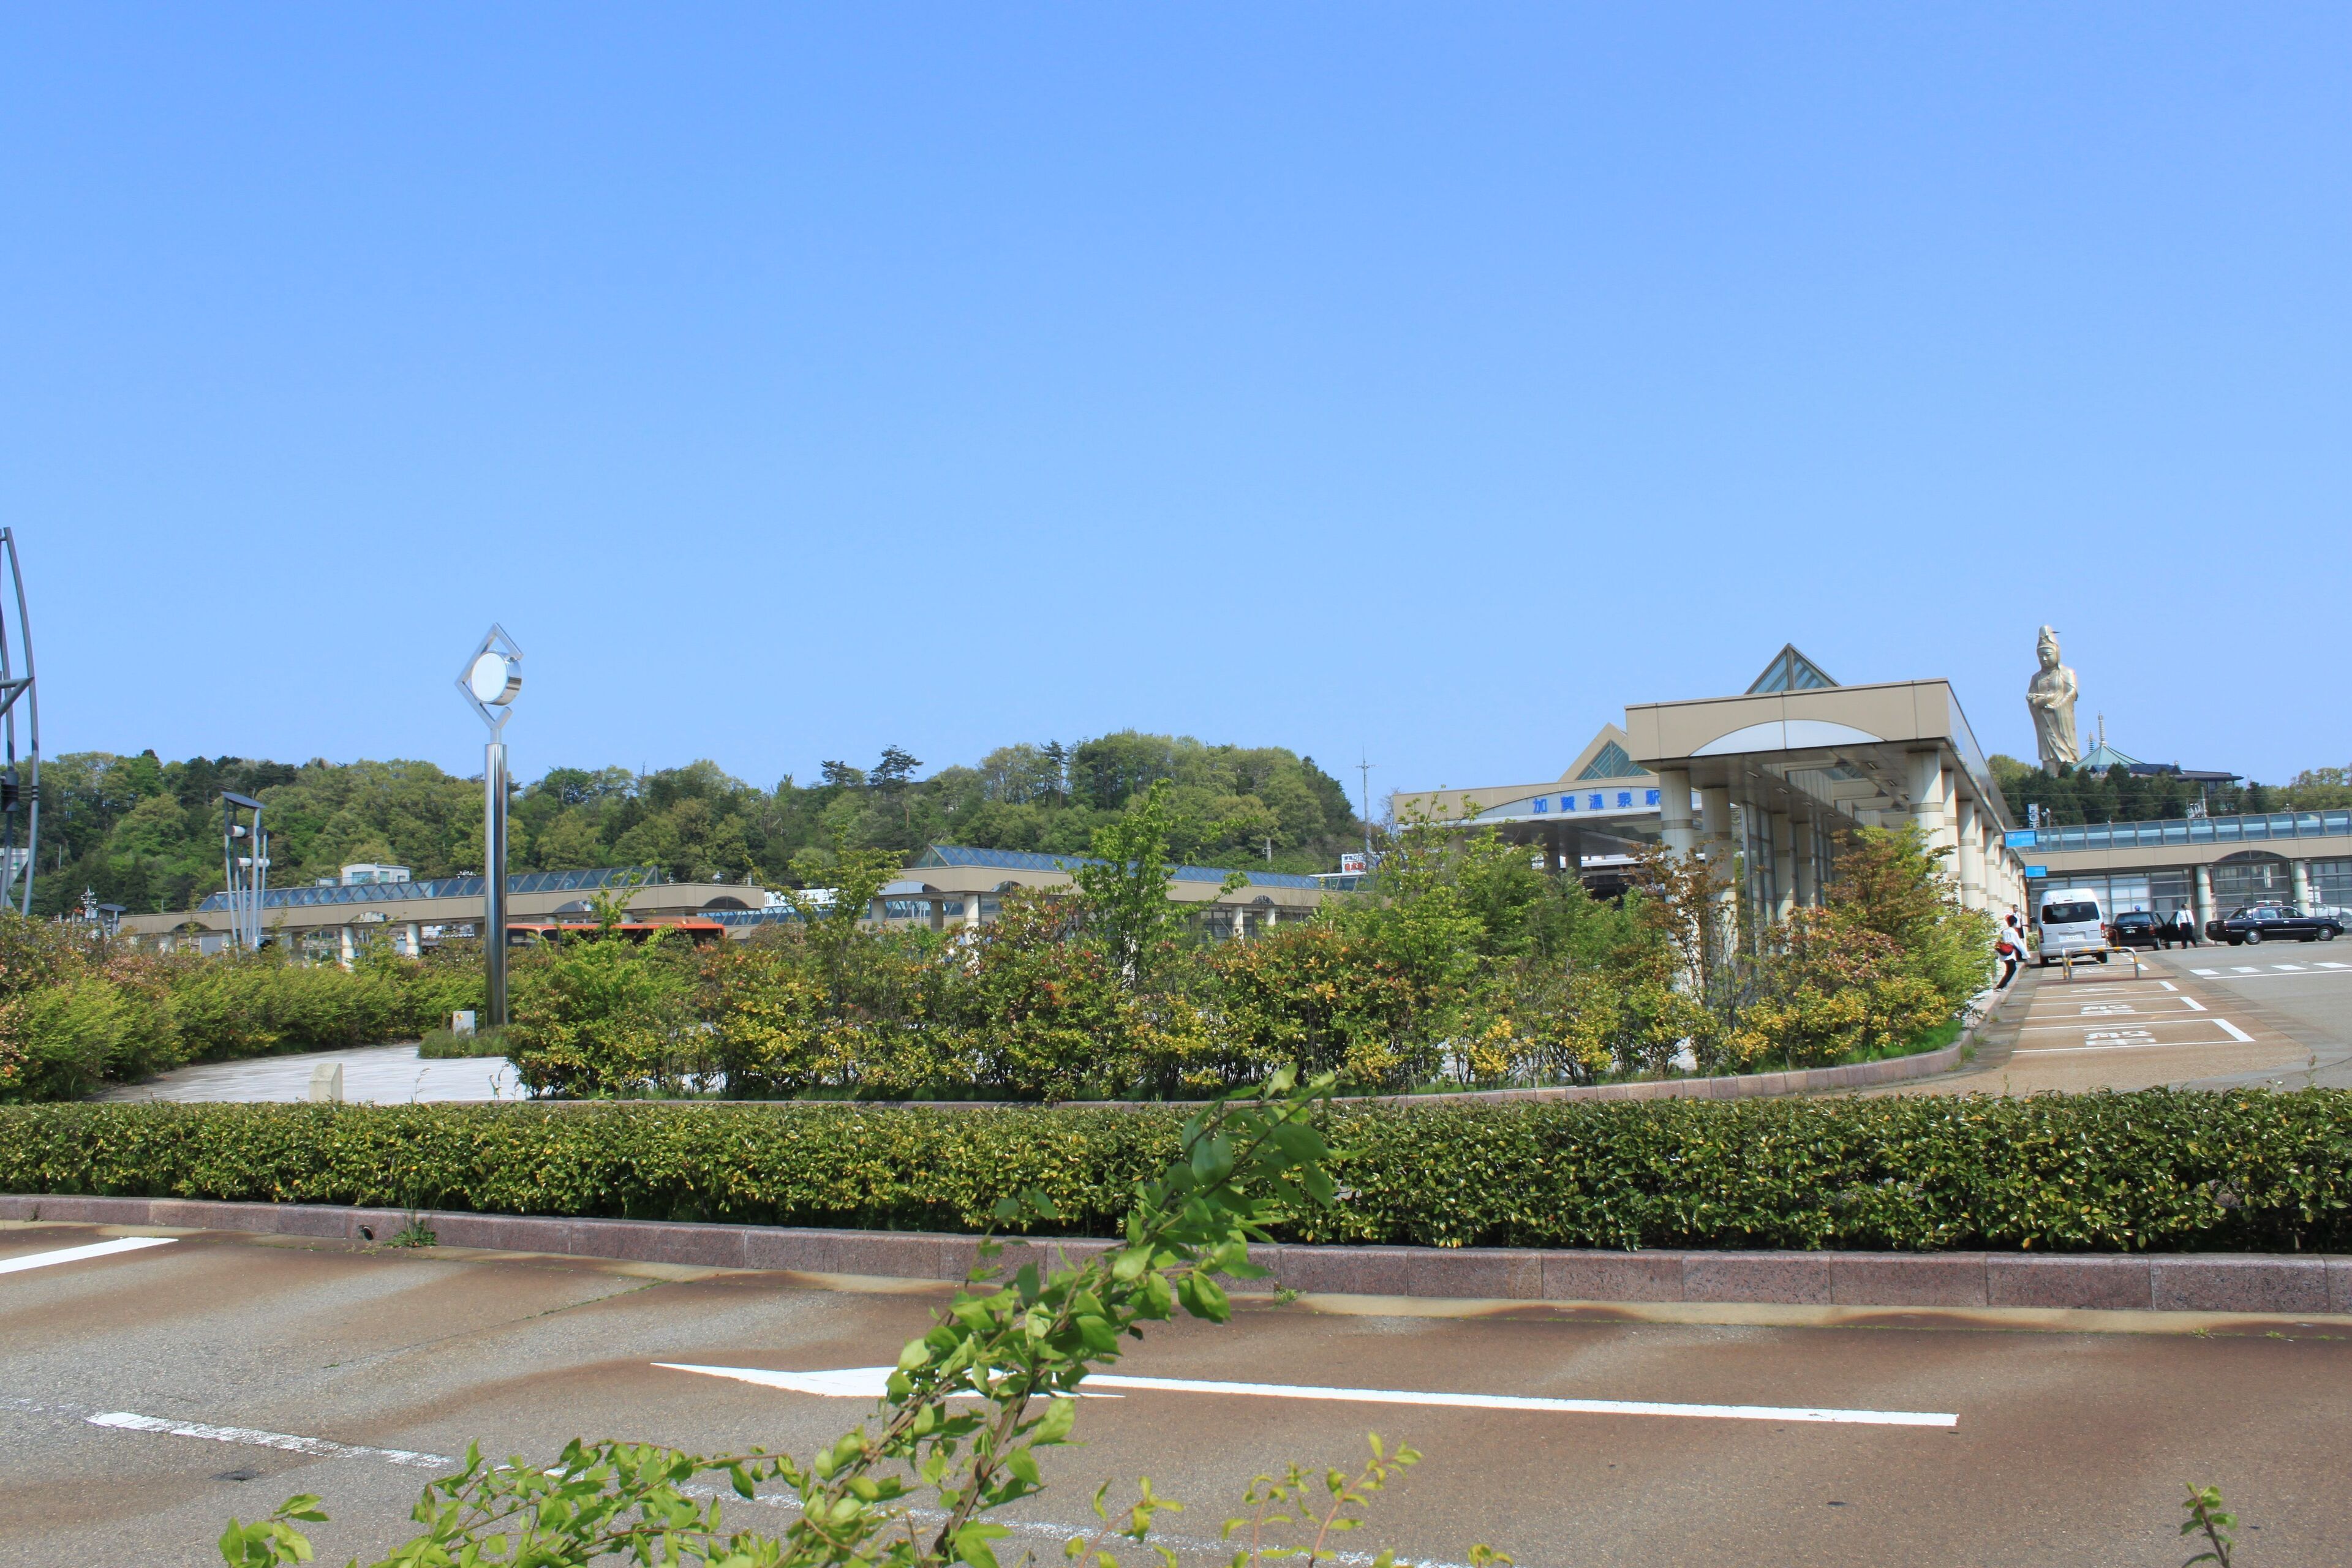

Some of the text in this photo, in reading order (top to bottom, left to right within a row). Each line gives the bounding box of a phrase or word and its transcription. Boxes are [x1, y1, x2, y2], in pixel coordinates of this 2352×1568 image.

[1532, 789, 1660, 814] 加賀温泉駅
